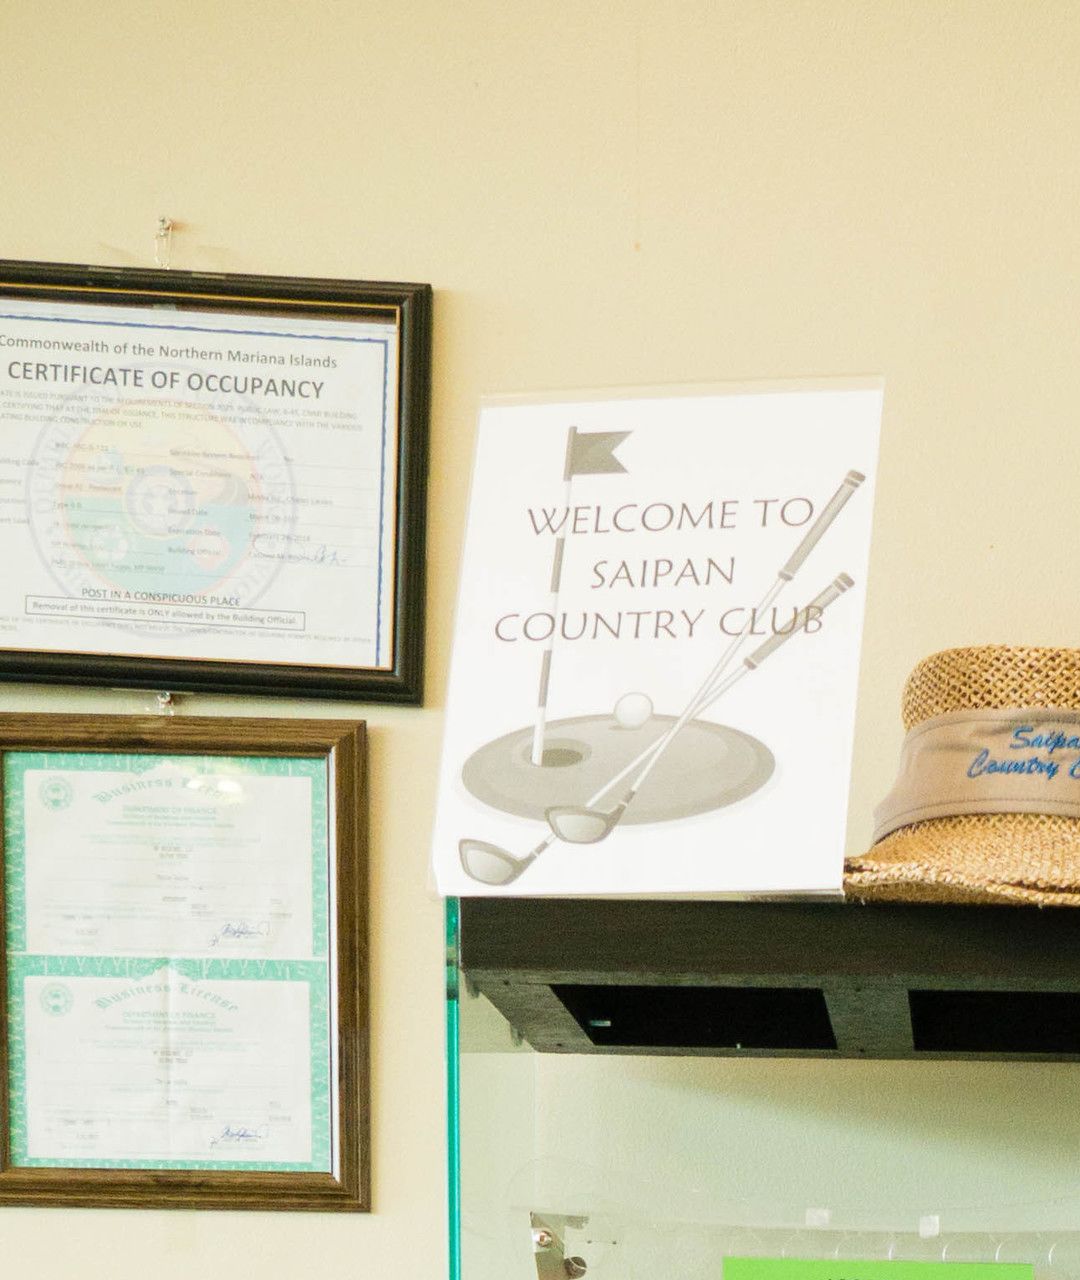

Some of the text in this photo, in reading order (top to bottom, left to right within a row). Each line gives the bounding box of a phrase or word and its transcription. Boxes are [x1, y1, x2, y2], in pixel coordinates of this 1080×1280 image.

[0, 334, 338, 368] Commonwealth of the Northern Mariana Islands
[8, 360, 325, 400] CERTIFICATE OF OCCUPANCY
[527, 497, 815, 537] WELCOME TO
[591, 556, 736, 590] SAIPAN
[82, 587, 240, 607] POST IN A CONSPICUOUS PLACE
[148, 608, 170, 618] ONLY
[494, 605, 824, 643] COUNTRY CLUB
[967, 748, 1060, 779] Country
